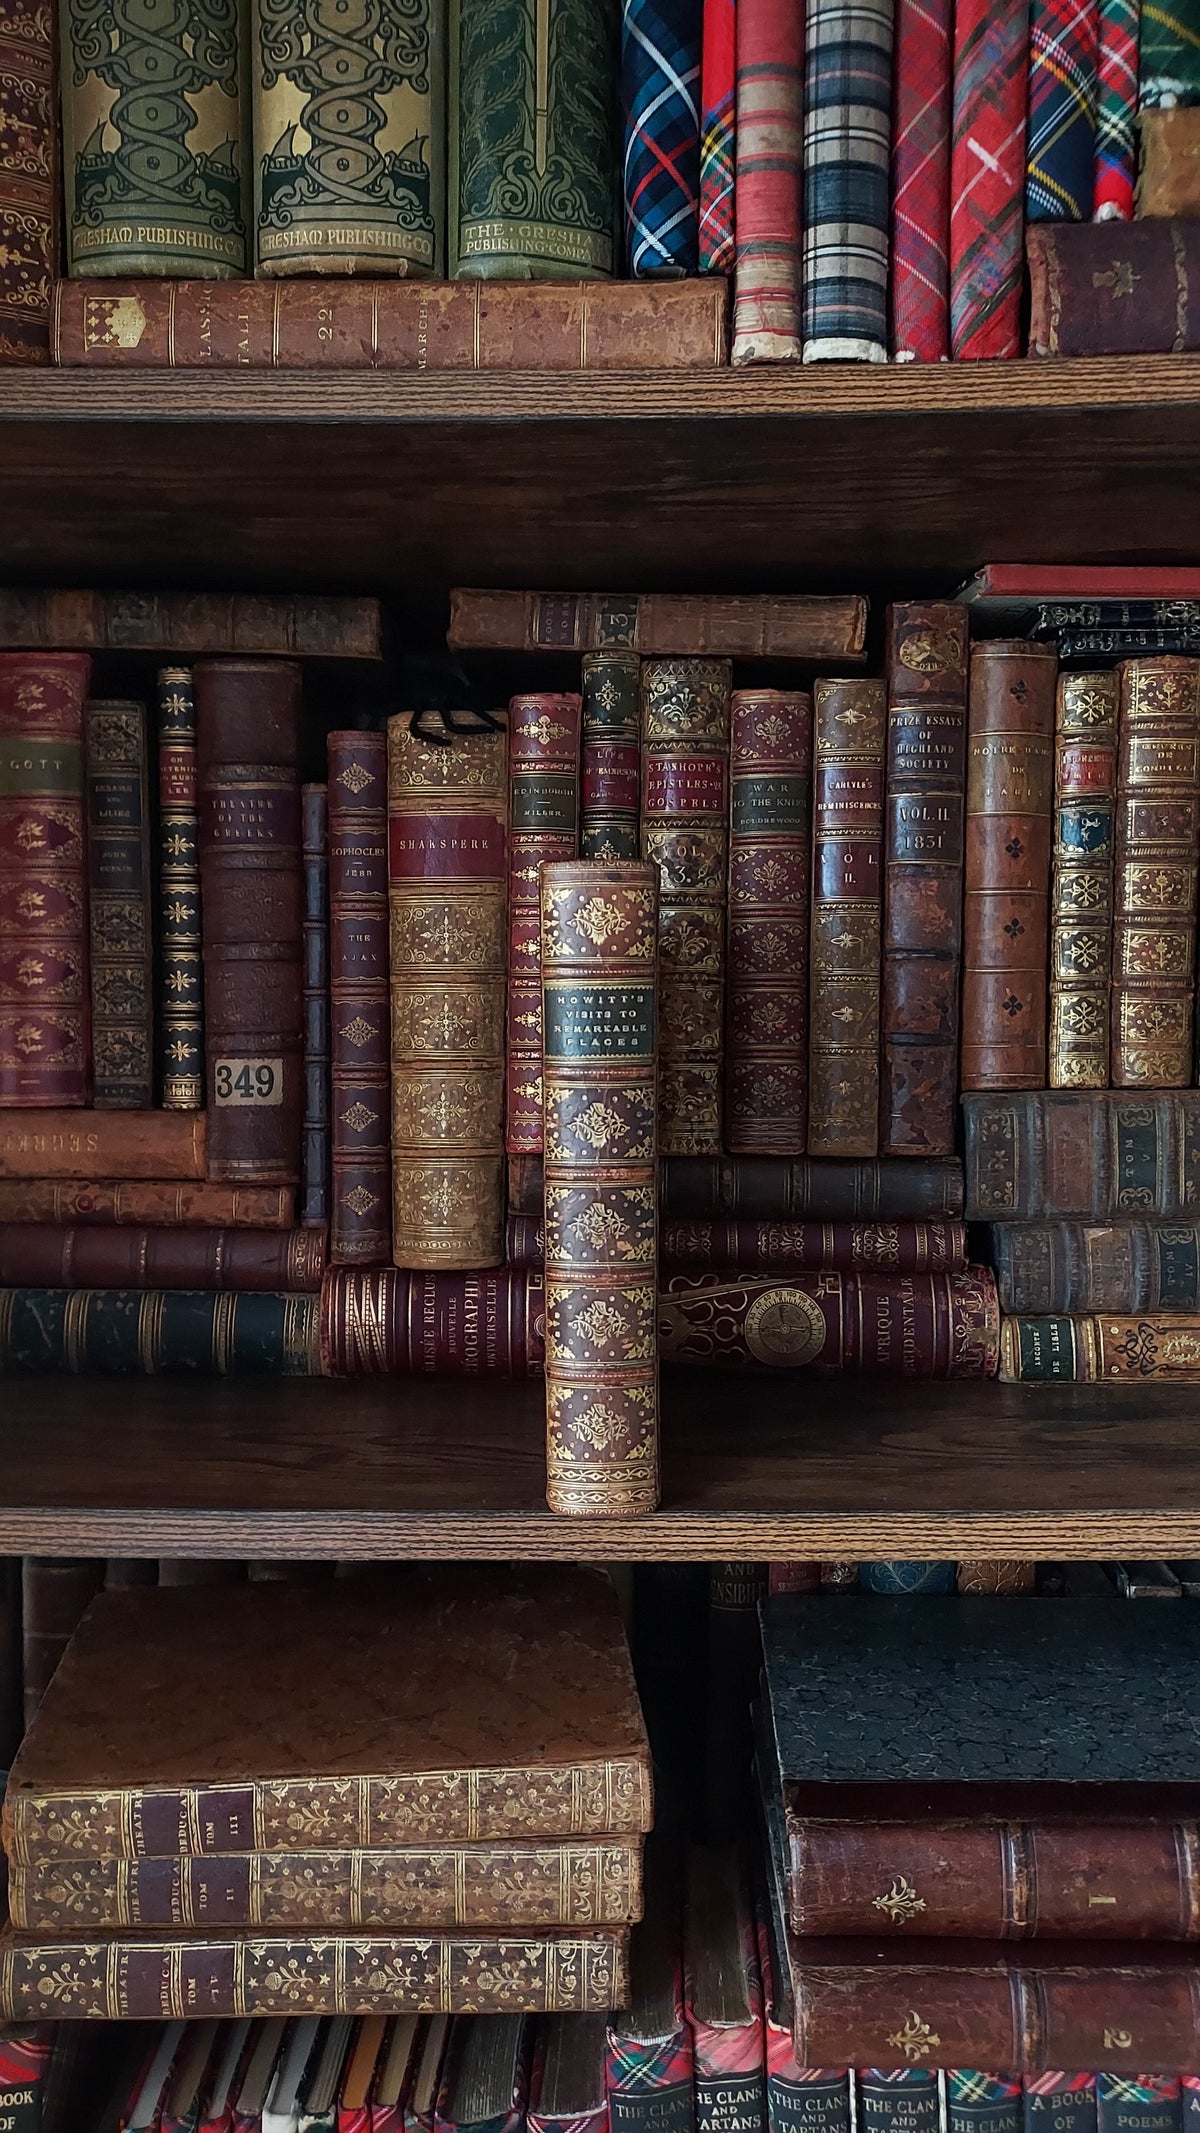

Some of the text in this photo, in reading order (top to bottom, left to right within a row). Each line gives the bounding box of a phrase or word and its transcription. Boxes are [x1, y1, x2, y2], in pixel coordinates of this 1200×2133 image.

[137, 227, 223, 252] PUBLISHING
[327, 229, 412, 249] PUBLISHING
[465, 223, 603, 247] THE GRESHA
[890, 715, 963, 727] PRIZE ESSAYS
[918, 730, 934, 740] OF
[896, 743, 955, 755] HIGHLAND
[898, 758, 950, 769] SOCIETY
[752, 783, 789, 792] WAR
[212, 799, 274, 809] THEATRE
[648, 798, 718, 809] GOSPELS
[751, 798, 771, 807] THE
[213, 828, 274, 838] GREEKS
[400, 838, 489, 850] SHAKSPERE
[904, 834, 943, 850] 1831
[331, 847, 386, 857] SOPHOCLES
[348, 933, 372, 943] THE
[341, 953, 378, 962] AJAX
[557, 994, 645, 1005] HOWITT'S
[565, 1009, 638, 1019] VISITS TO
[553, 1023, 648, 1034] REMARKABLE
[567, 1037, 639, 1047] PLACES
[217, 1065, 275, 1098] 349
[1125, 1138, 1134, 1178] TOM
[423, 1273, 437, 1324] RECLUS
[448, 1296, 457, 1355] NOUVELLE
[486, 1279, 497, 1368] UNIVERSELLE
[1049, 1323, 1061, 1374] DE LISLE
[229, 1814, 239, 1836] III
[204, 1821, 215, 1845] TOM
[199, 1882, 208, 1910] TOM
[226, 1887, 235, 1901] II
[187, 1977, 197, 2006] TOM
[1104, 2027, 1132, 2048] 2
[716, 2086, 762, 2105] CLANS
[772, 2089, 801, 2111] THE
[862, 2097, 893, 2114] THE
[1031, 2096, 1046, 2111] A
[615, 2103, 646, 2119] THE
[710, 2106, 738, 2117] AND
[799, 2113, 827, 2123] AND
[643, 2118, 670, 2130] AND
[697, 2114, 762, 2131] ARTANS
[890, 2116, 918, 2127] AND
[951, 2117, 974, 2133] HE
[1054, 2116, 1077, 2131] OF
[1117, 2114, 1173, 2128] POEMS
